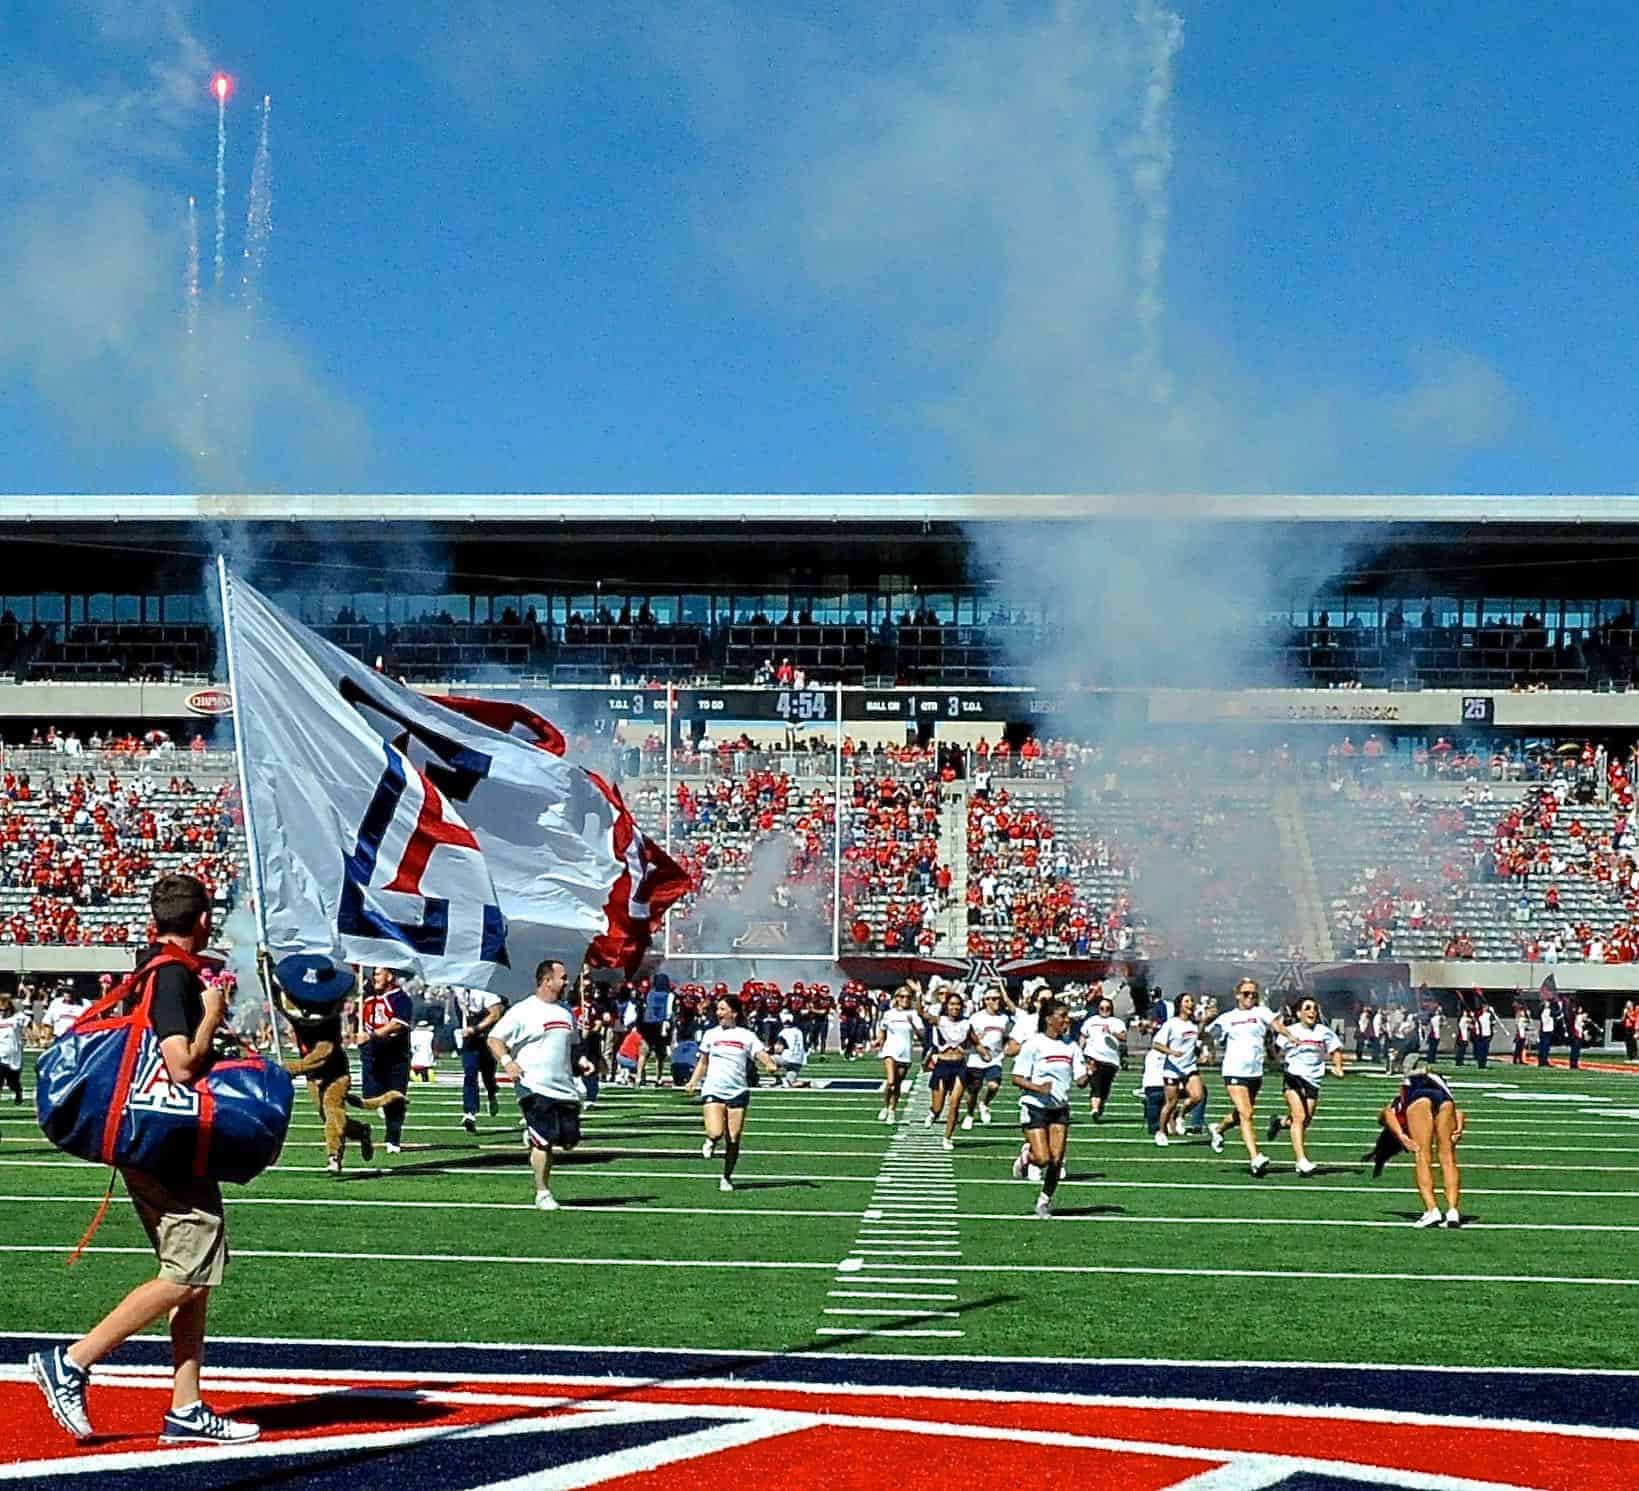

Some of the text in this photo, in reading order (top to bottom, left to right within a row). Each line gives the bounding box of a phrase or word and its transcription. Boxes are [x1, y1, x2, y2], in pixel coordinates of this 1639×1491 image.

[632, 695, 644, 714] 3
[697, 700, 710, 710] TO
[776, 692, 827, 719] 4:54
[948, 696, 959, 716] 3
[1464, 699, 1486, 719] 25
